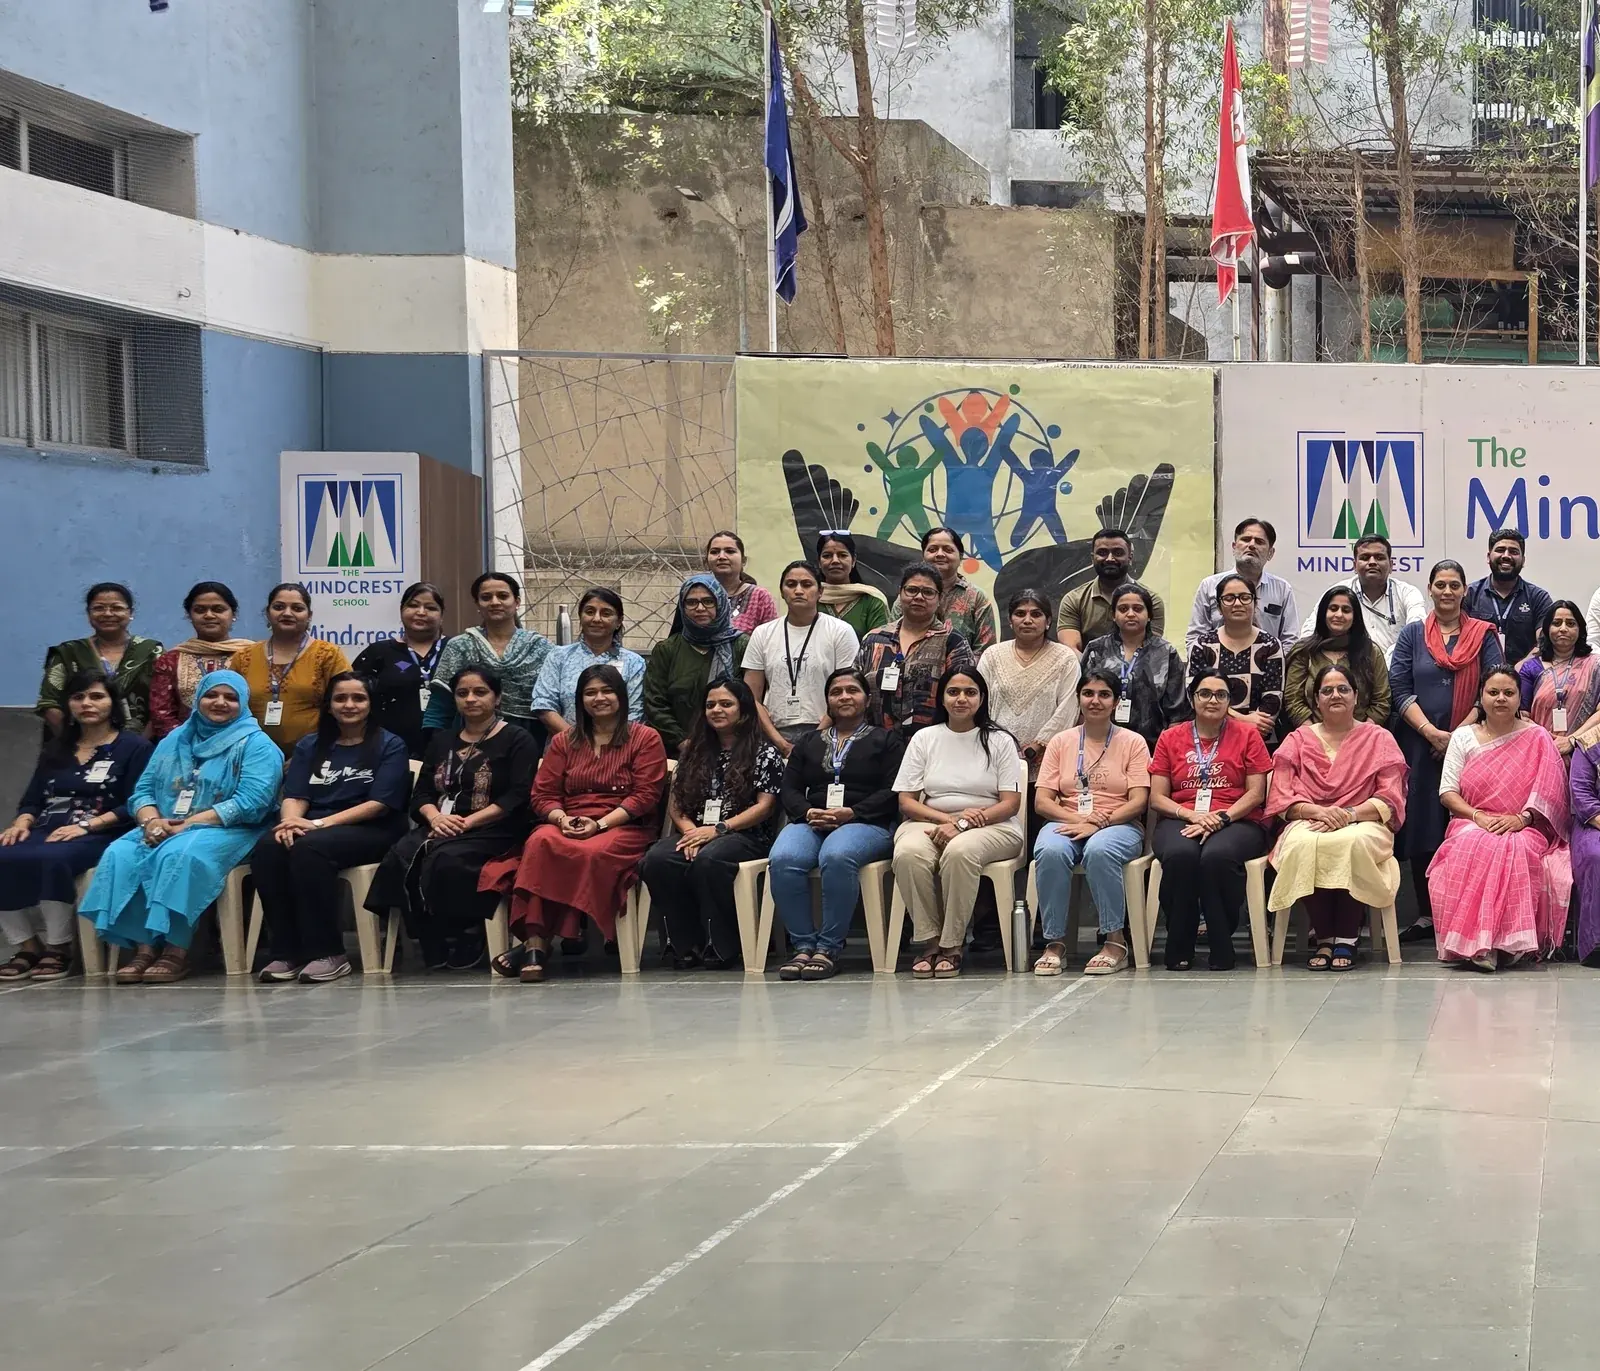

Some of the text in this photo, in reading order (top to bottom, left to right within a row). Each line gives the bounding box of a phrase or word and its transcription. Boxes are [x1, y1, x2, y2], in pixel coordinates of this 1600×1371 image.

[1468, 436, 1527, 468] The
[1297, 556, 1424, 572] MINDEST
[341, 569, 360, 577] THE
[299, 580, 404, 594] MINDCREST
[332, 598, 369, 606] SCHOOL
